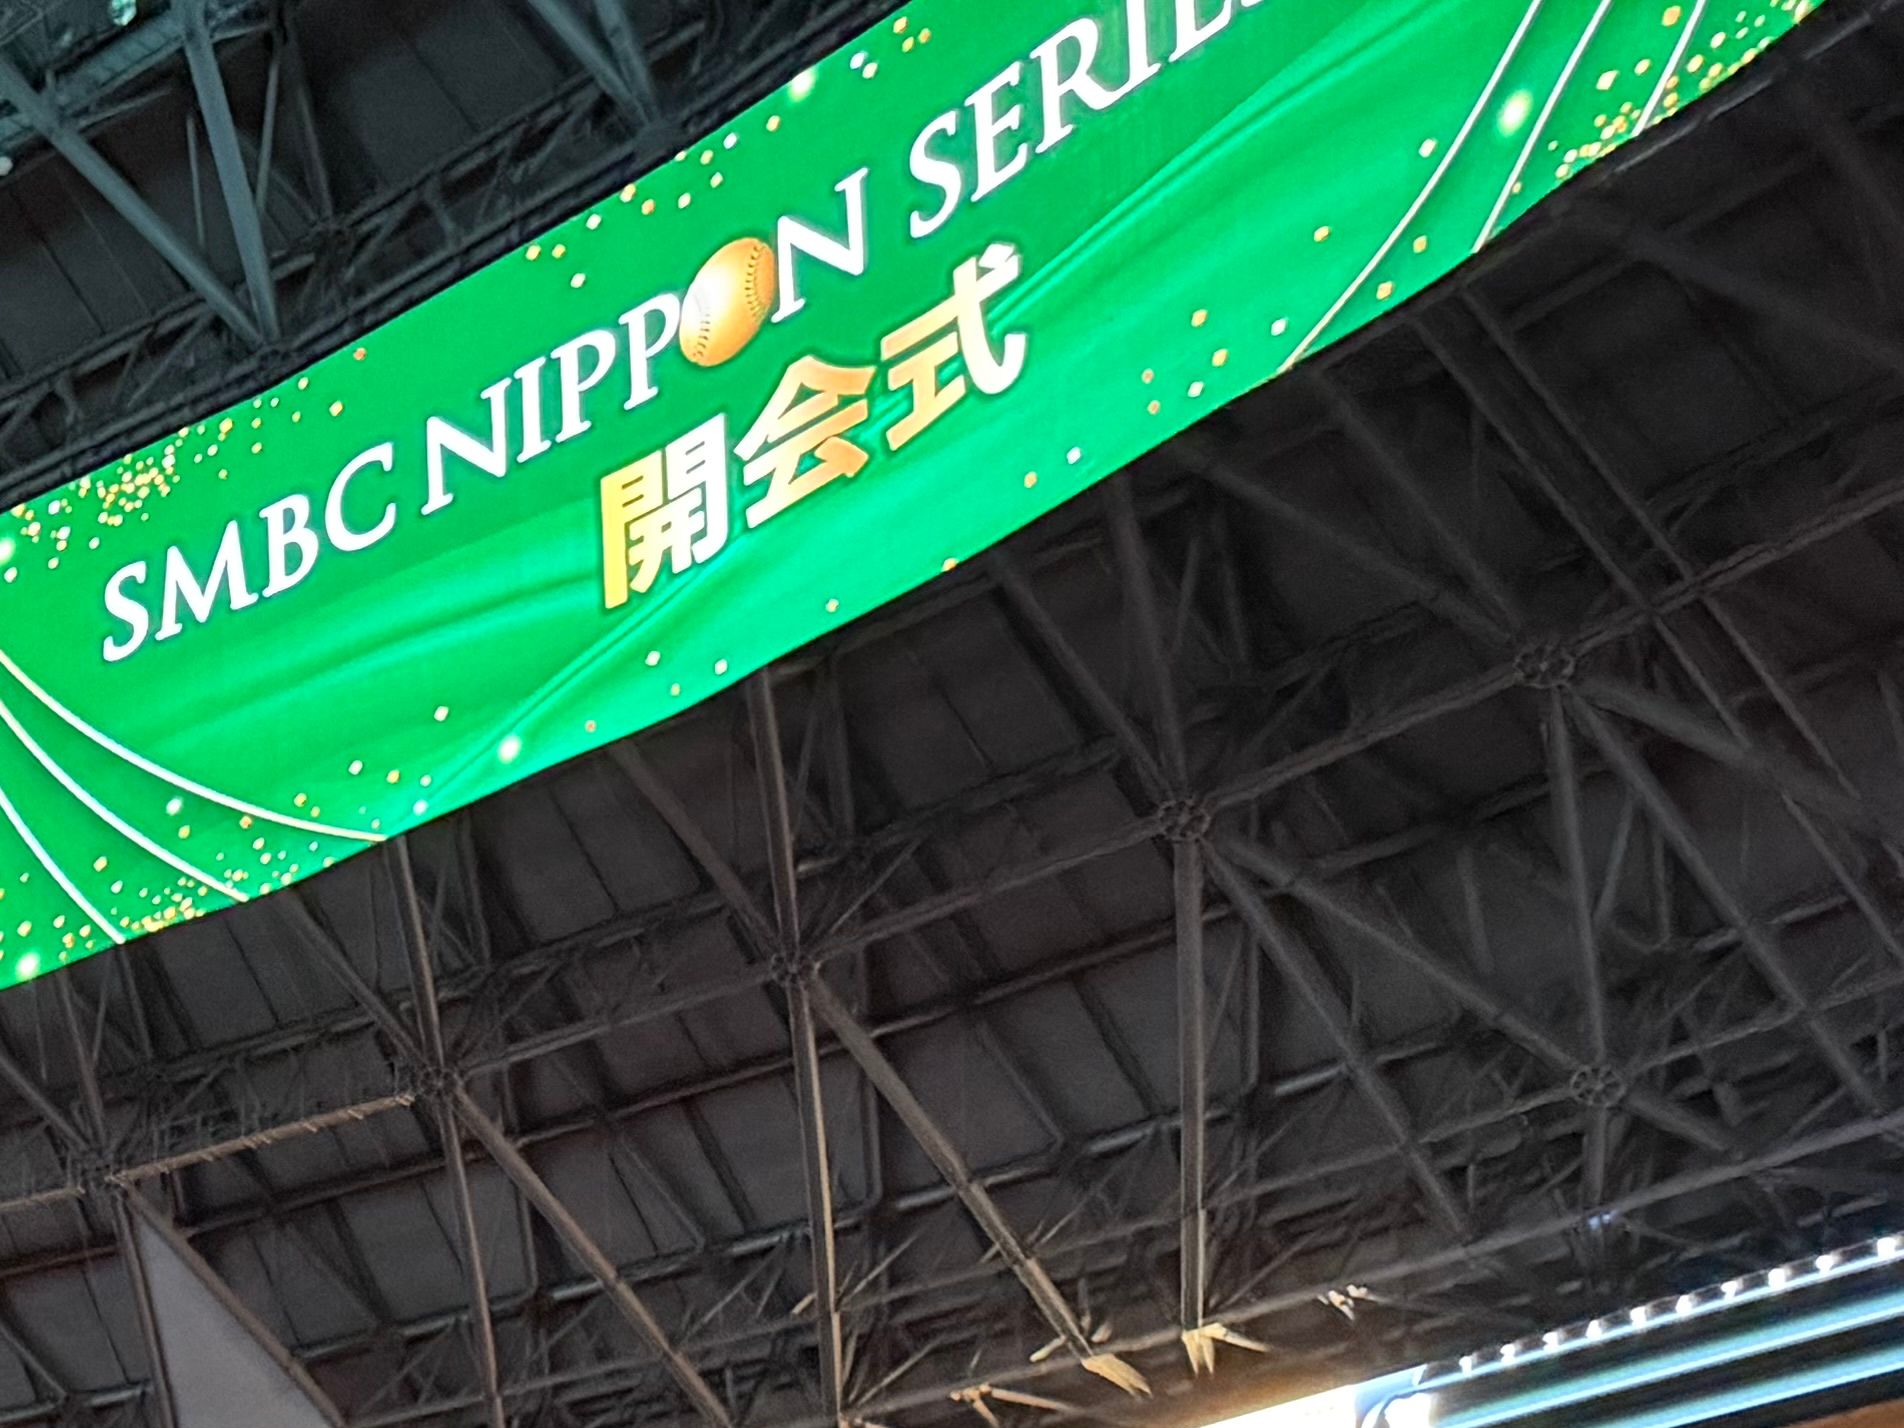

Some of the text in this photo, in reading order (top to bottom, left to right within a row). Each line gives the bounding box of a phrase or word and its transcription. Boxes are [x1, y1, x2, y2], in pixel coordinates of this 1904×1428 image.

[100, 0, 1267, 662] SMBC NIPPON SERIE
[601, 244, 1027, 612] 開会式
